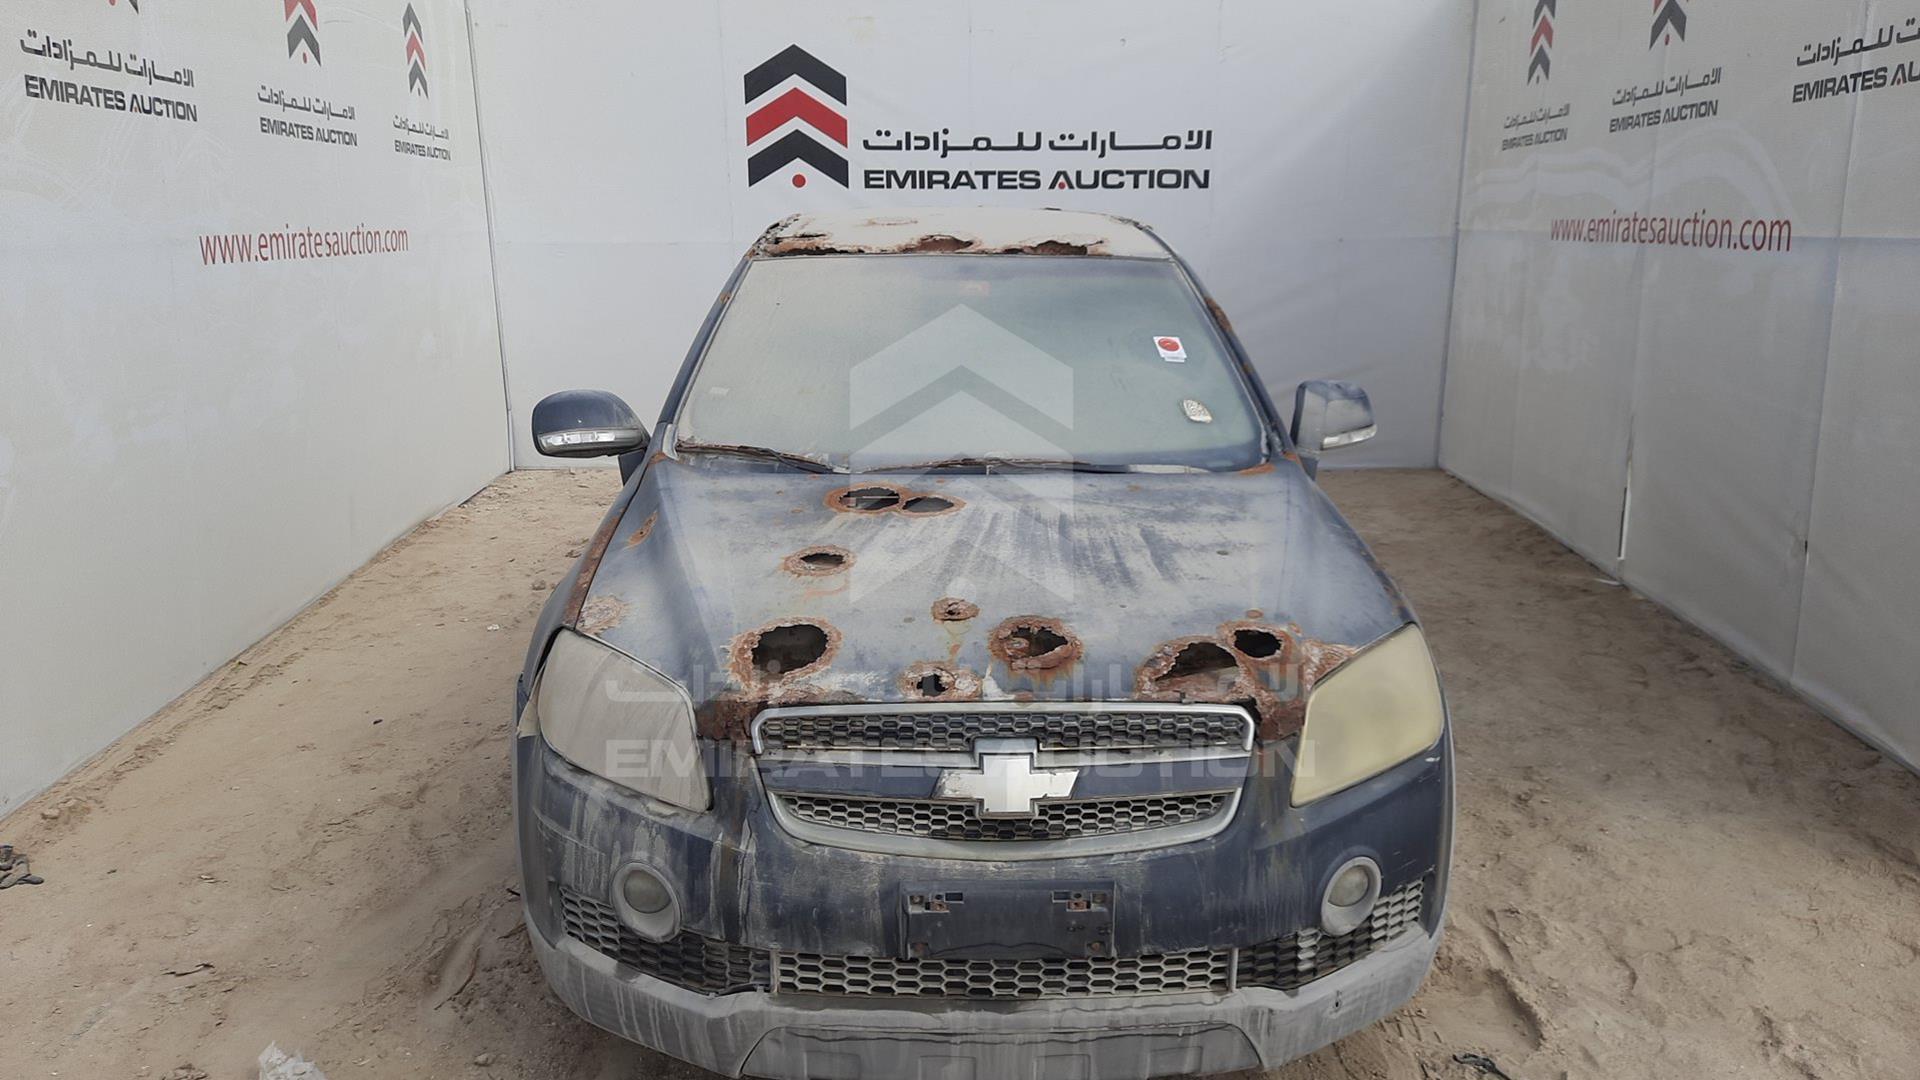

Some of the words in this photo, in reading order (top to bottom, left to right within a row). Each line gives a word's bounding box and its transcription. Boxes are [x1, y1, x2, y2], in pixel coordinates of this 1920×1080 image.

[19, 28, 123, 71] للمزادات
[1796, 24, 1894, 66] للمزادات
[24, 74, 127, 112] EMIRATES
[129, 93, 198, 122] AUCTION
[257, 84, 312, 112] للمزادات
[1612, 80, 1666, 107] للمزادات
[1792, 66, 1888, 103] EMIRATES
[260, 116, 314, 141] EMIRATES
[315, 127, 358, 146] AUCTION
[1609, 110, 1661, 133] EMIRATES
[1662, 99, 1719, 124] AUCTION
[394, 139, 426, 157] EMIRATES
[862, 128, 1042, 159] للمزادات
[863, 169, 1042, 190] EMIRATES
[1048, 169, 1211, 190] AUCTION
[199, 222, 410, 266] www.emiratesauction.com
[1551, 208, 1792, 252] www.emiratesauction.com
